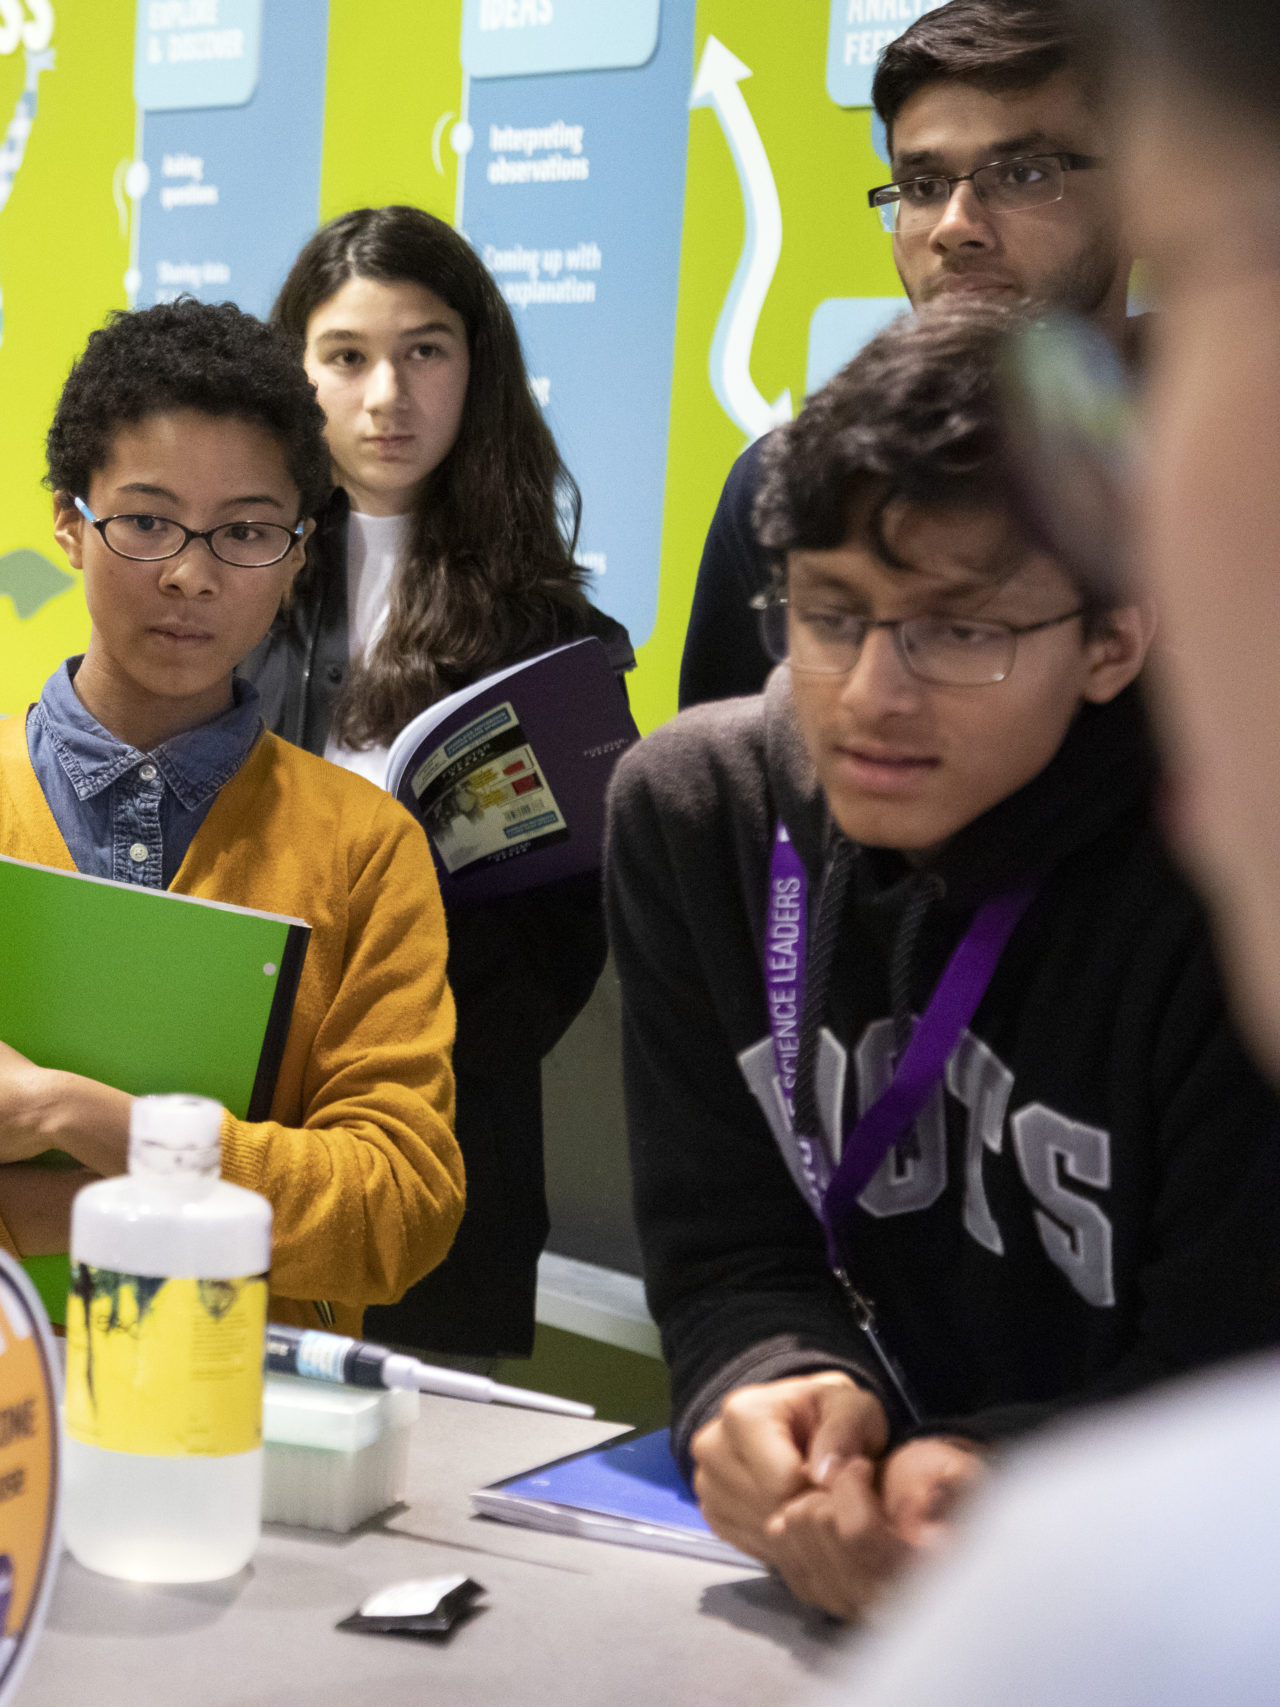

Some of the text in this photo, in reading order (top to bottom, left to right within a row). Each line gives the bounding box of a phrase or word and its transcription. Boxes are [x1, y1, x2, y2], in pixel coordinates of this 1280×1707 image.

[479, 0, 553, 31] IDEAS
[489, 120, 583, 157] Interpreting
[487, 153, 589, 184] observations
[542, 250, 564, 277] up
[565, 242, 602, 271] with
[772, 877, 802, 1089] SCIENCE LEADERS
